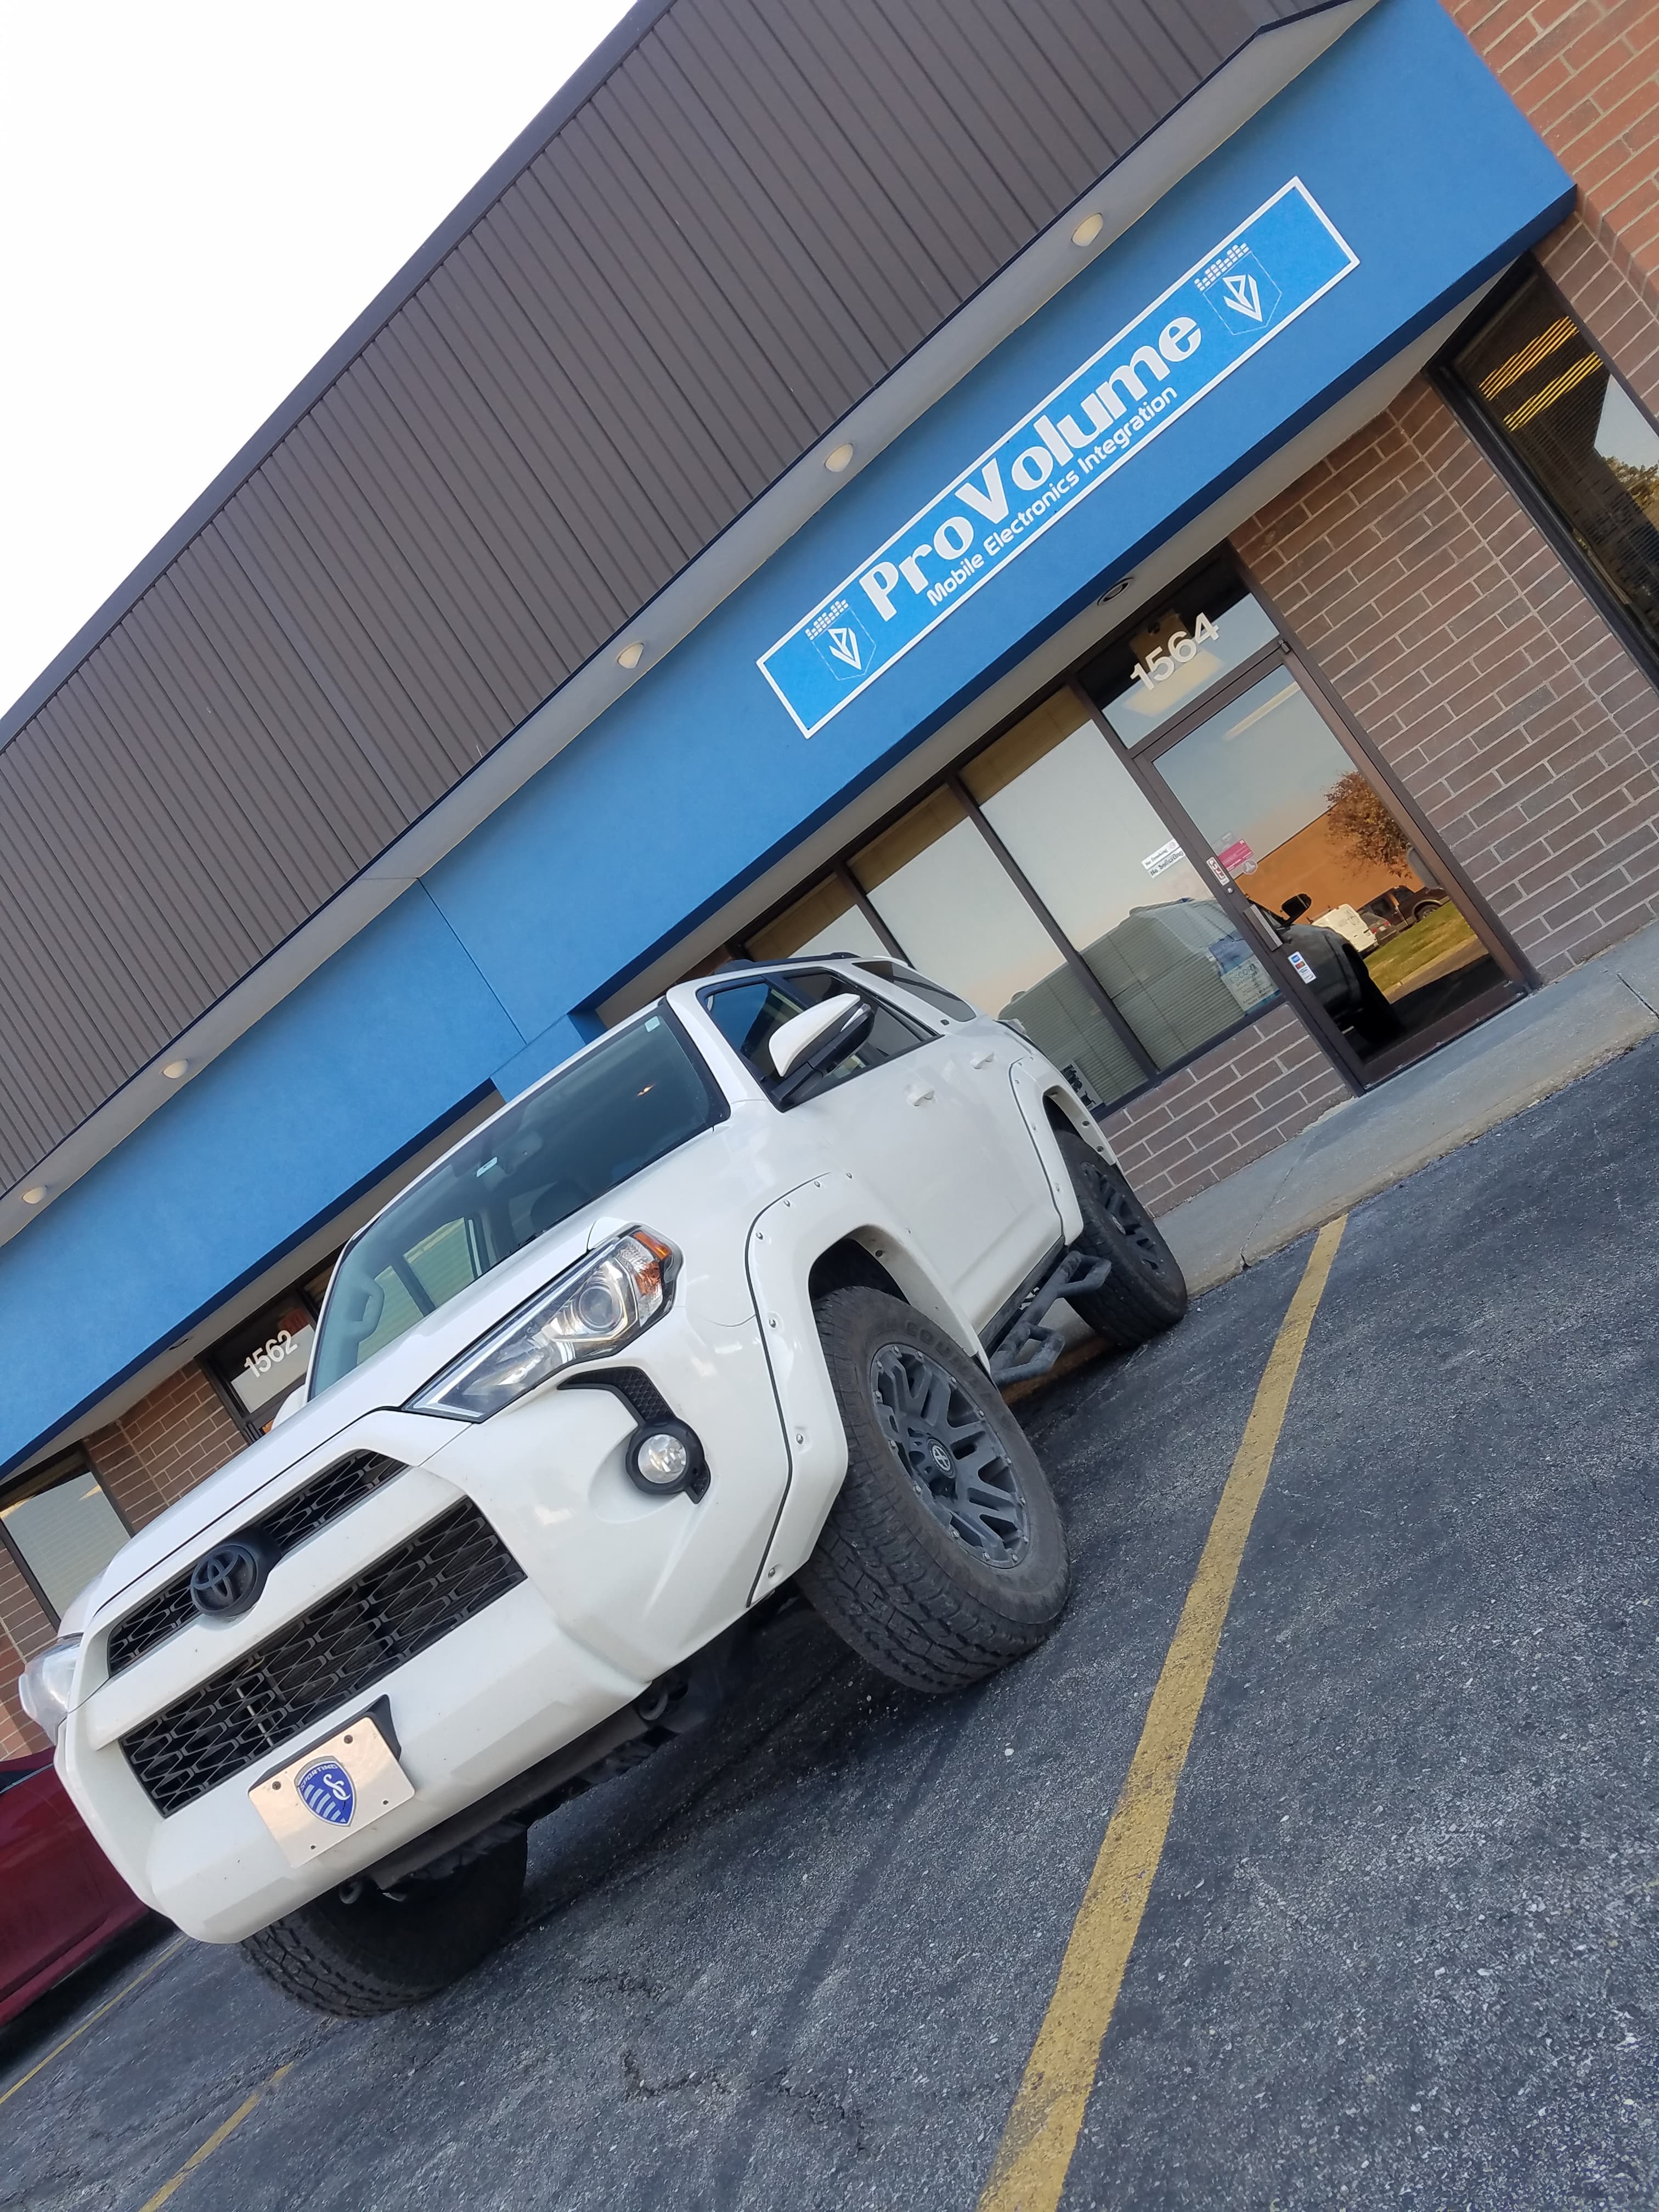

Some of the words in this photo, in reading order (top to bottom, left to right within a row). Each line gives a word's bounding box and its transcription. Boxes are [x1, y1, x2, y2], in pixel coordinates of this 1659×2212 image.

[859, 317, 1202, 622] ProVolume
[927, 554, 985, 606] Mobile
[983, 471, 1080, 557] Electronics
[1078, 387, 1178, 474] Integration
[1130, 612, 1220, 691] 1564
[244, 1330, 298, 1378] 1562
[300, 1764, 338, 1791] SPORTING
